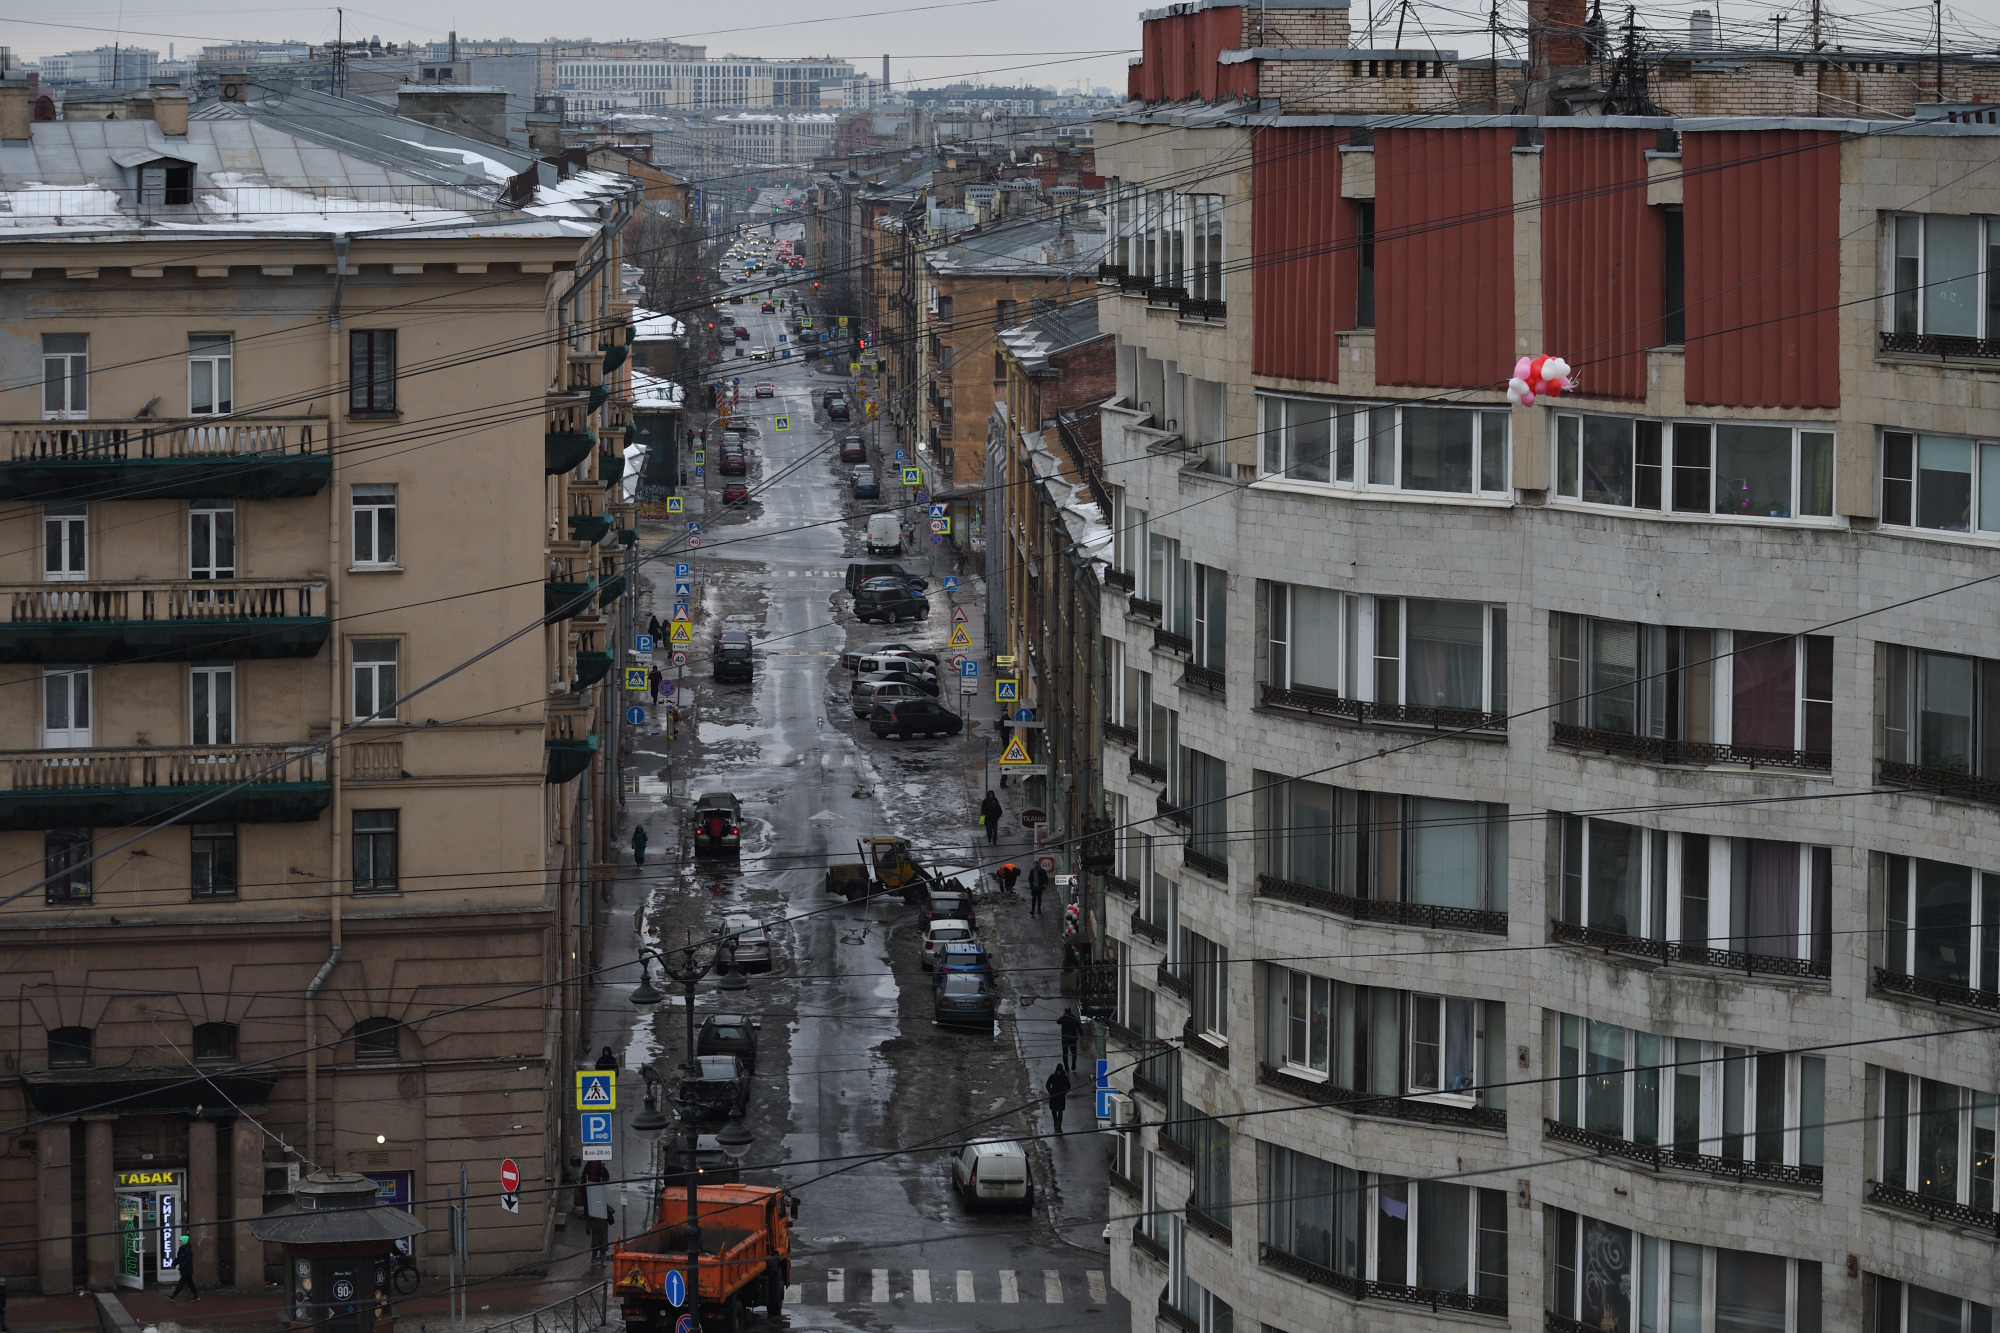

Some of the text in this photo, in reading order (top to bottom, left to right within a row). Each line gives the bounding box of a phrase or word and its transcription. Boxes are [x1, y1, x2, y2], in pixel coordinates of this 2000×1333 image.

[678, 564, 687, 576] P
[640, 637, 650, 650] P
[965, 662, 975, 675] P
[589, 1116, 606, 1140] P
[118, 1172, 173, 1185] ТАБАК
[163, 1195, 174, 1268] СИГАРЕТЫ
